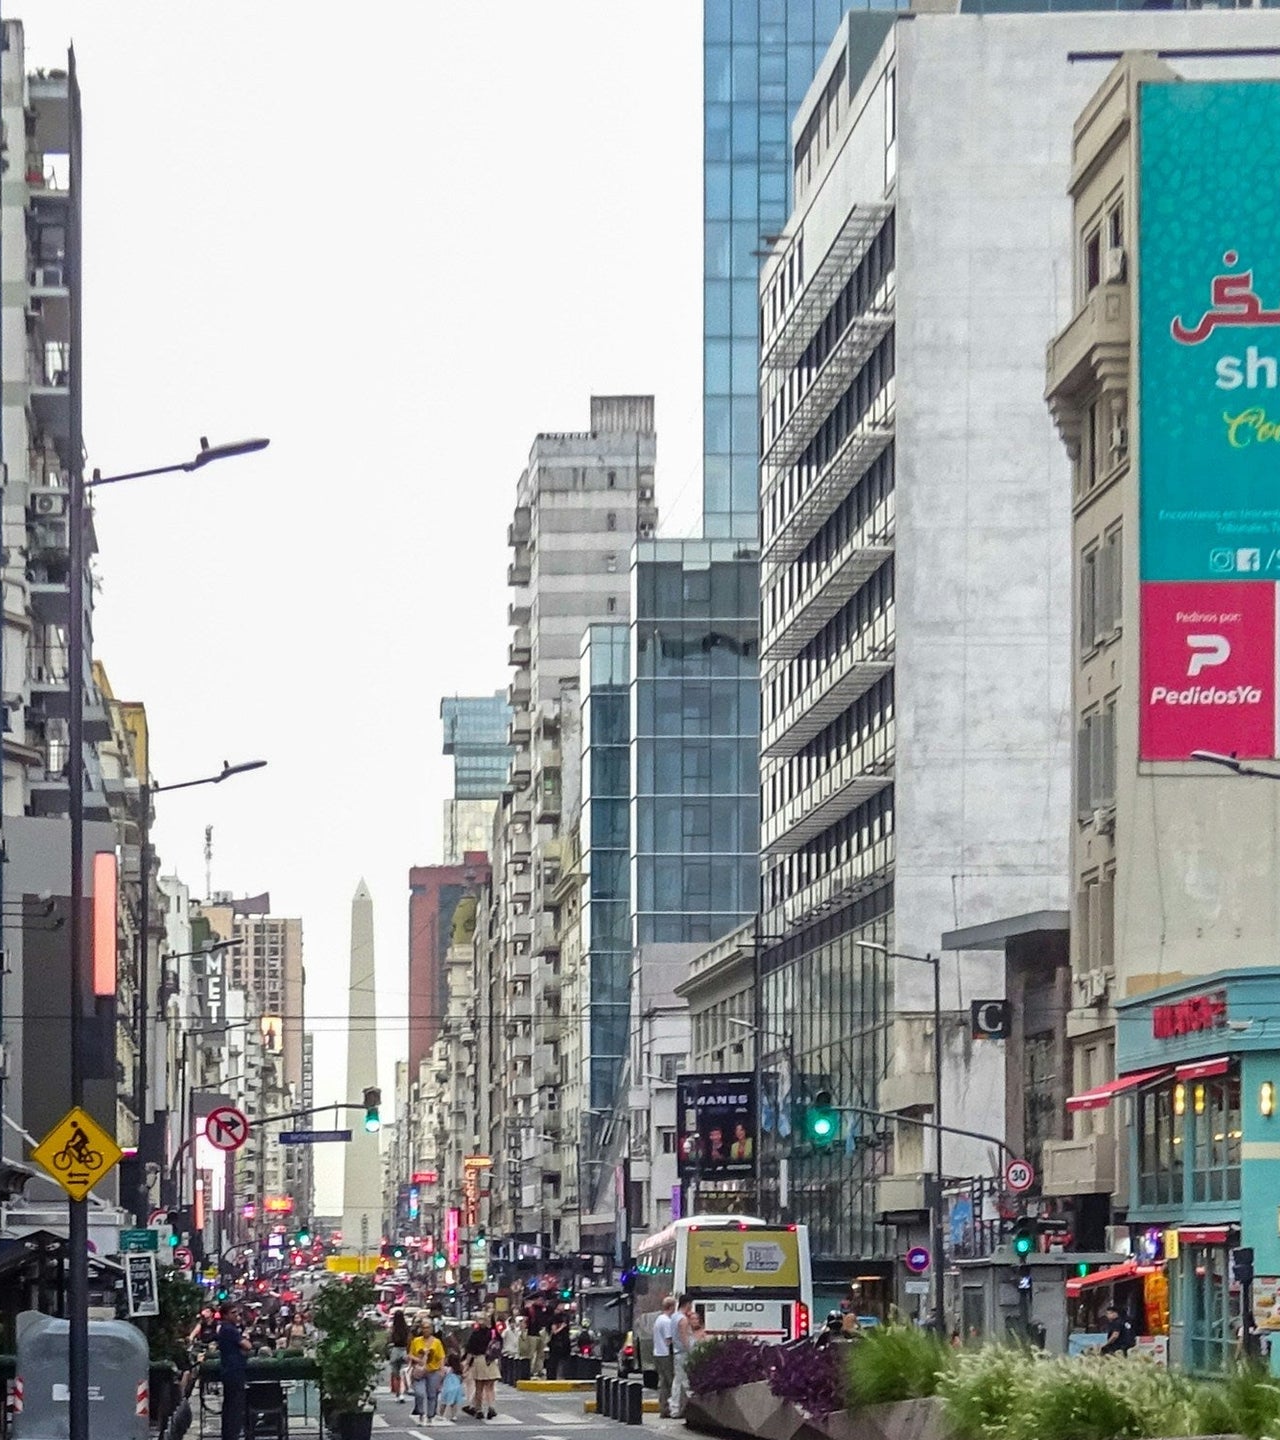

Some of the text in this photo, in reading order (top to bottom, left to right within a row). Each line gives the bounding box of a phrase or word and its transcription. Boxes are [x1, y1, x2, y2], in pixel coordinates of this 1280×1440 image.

[1149, 684, 1263, 706] PedidosYa
[977, 1002, 1003, 1032] C
[1010, 1169, 1027, 1182] 30
[723, 1302, 766, 1313] NUDO
